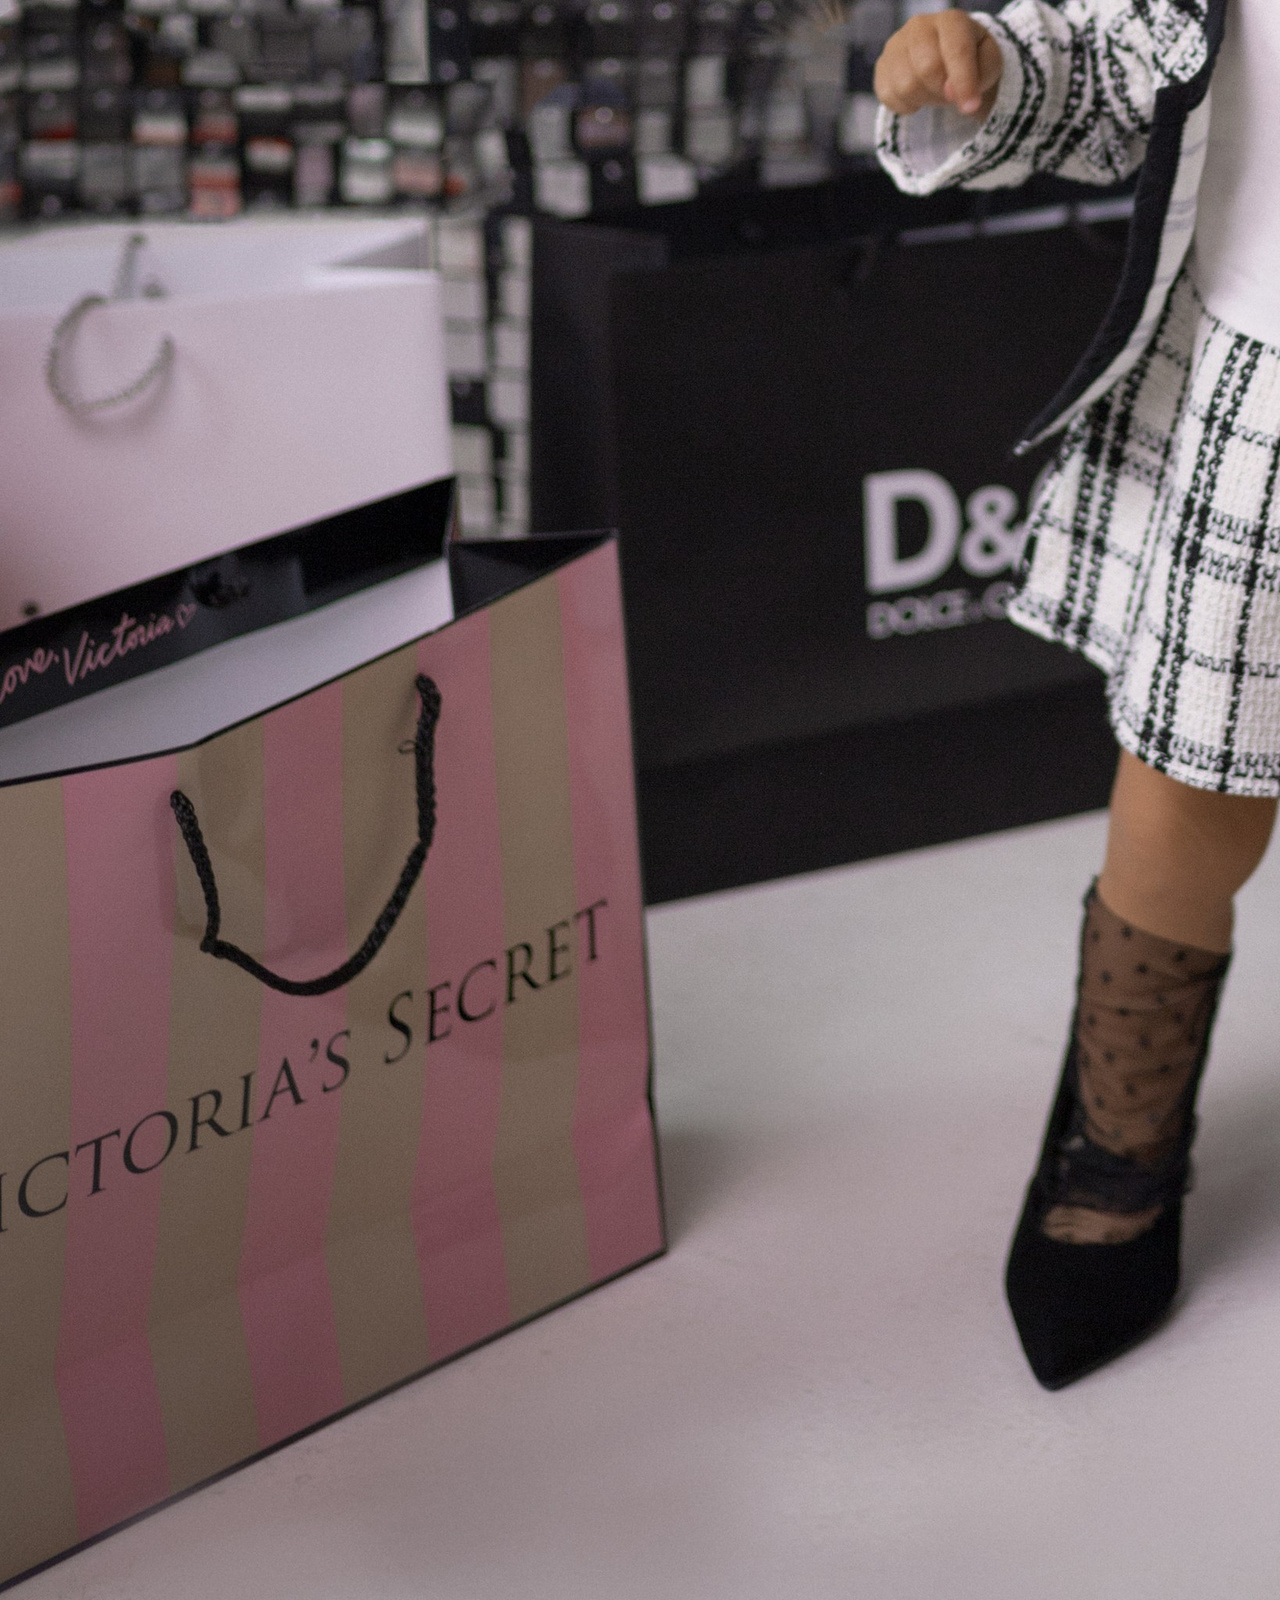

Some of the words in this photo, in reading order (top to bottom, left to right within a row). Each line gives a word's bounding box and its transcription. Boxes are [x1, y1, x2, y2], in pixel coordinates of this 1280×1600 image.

[863, 466, 1055, 595] D&
[63, 613, 174, 686] Victoria
[384, 899, 608, 1065] SECRET
